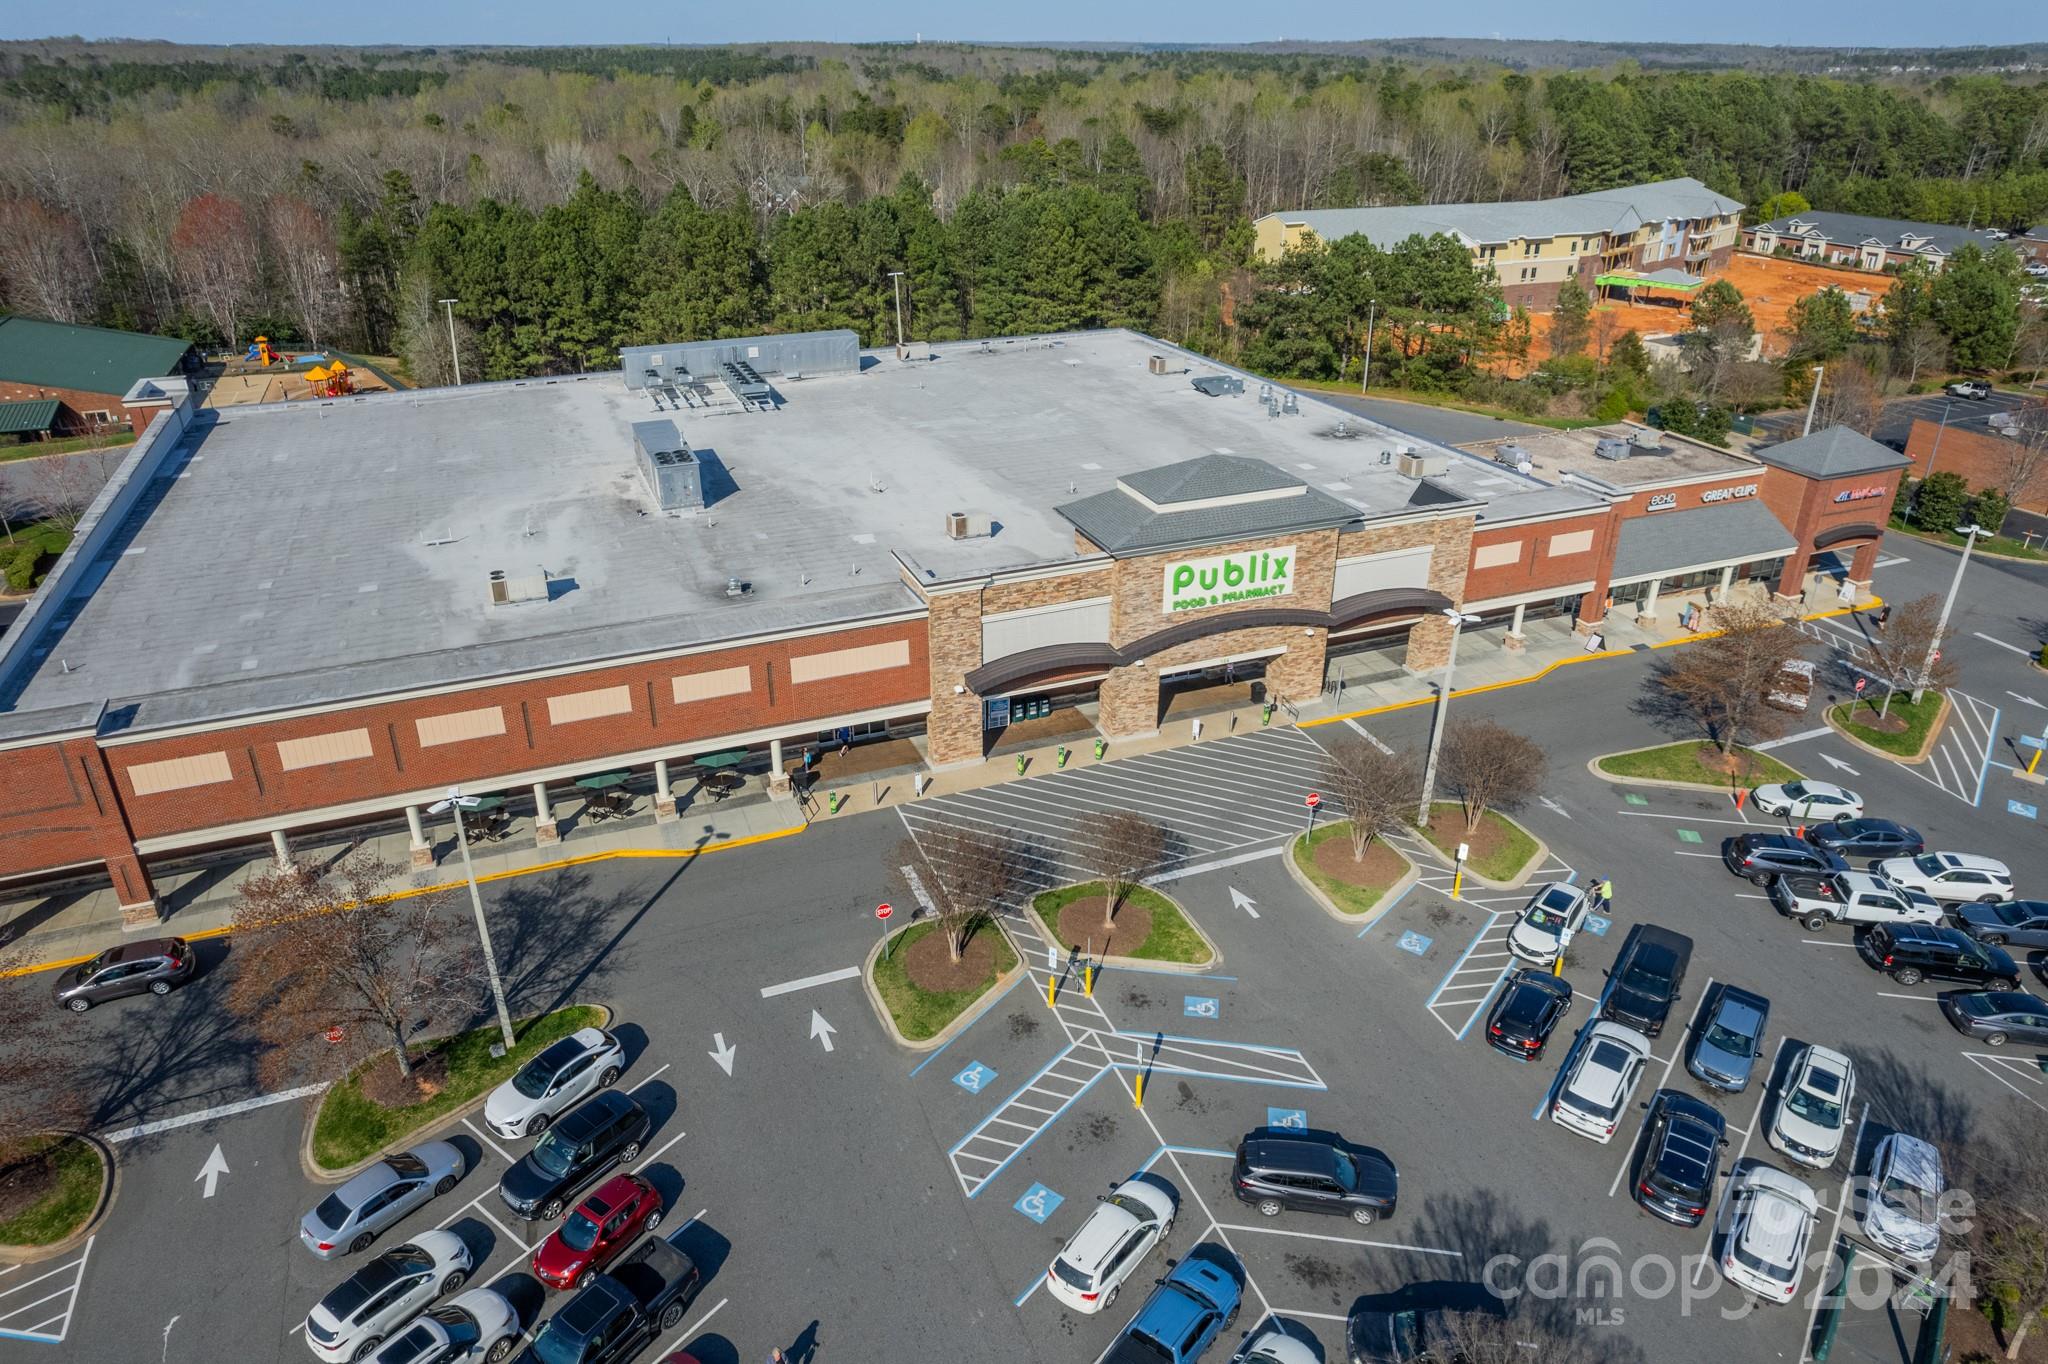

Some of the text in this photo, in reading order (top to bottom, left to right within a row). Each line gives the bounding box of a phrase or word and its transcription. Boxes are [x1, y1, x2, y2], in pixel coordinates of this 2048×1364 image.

[1702, 483, 1758, 503] GREAT CLIPS
[1172, 552, 1289, 595] Publix
[1172, 583, 1286, 611] FOOD & PHARMACY
